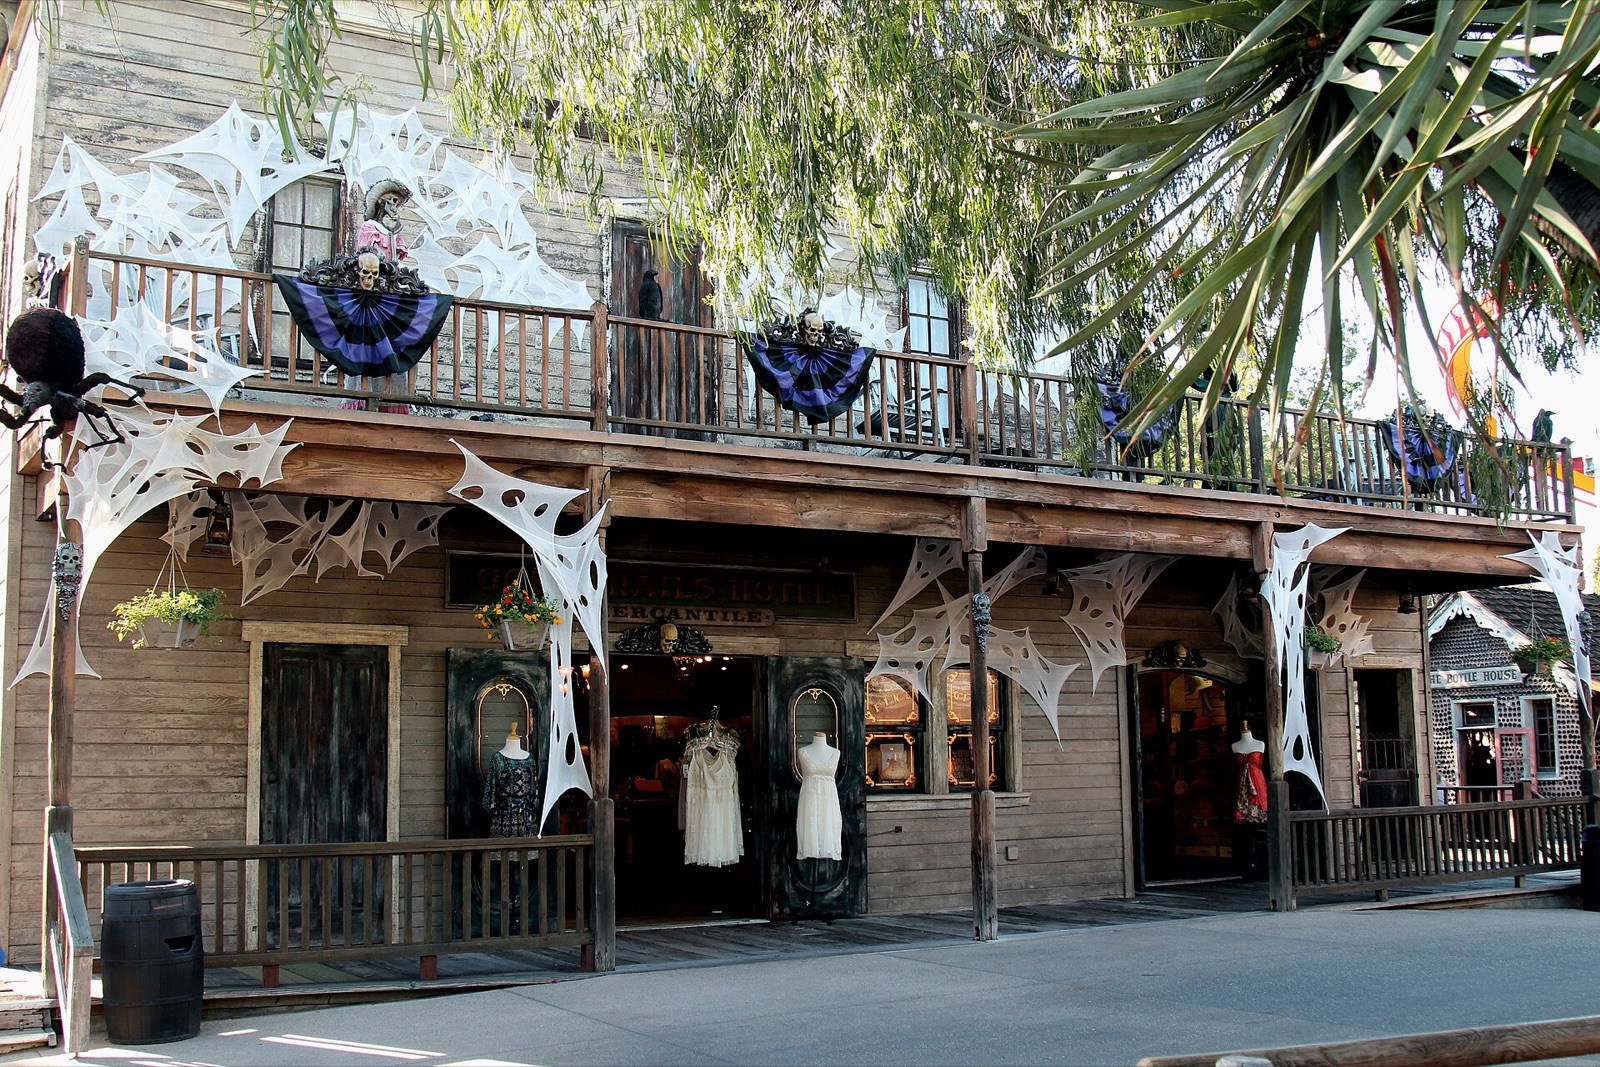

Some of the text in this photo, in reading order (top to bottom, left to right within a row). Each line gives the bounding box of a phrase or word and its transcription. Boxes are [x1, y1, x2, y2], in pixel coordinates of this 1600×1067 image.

[607, 574, 717, 601] RAILS
[729, 578, 833, 605] HOTEL
[607, 605, 763, 623] ERCANTILE
[1430, 669, 1518, 685] HE BOTTLE HOUSE
